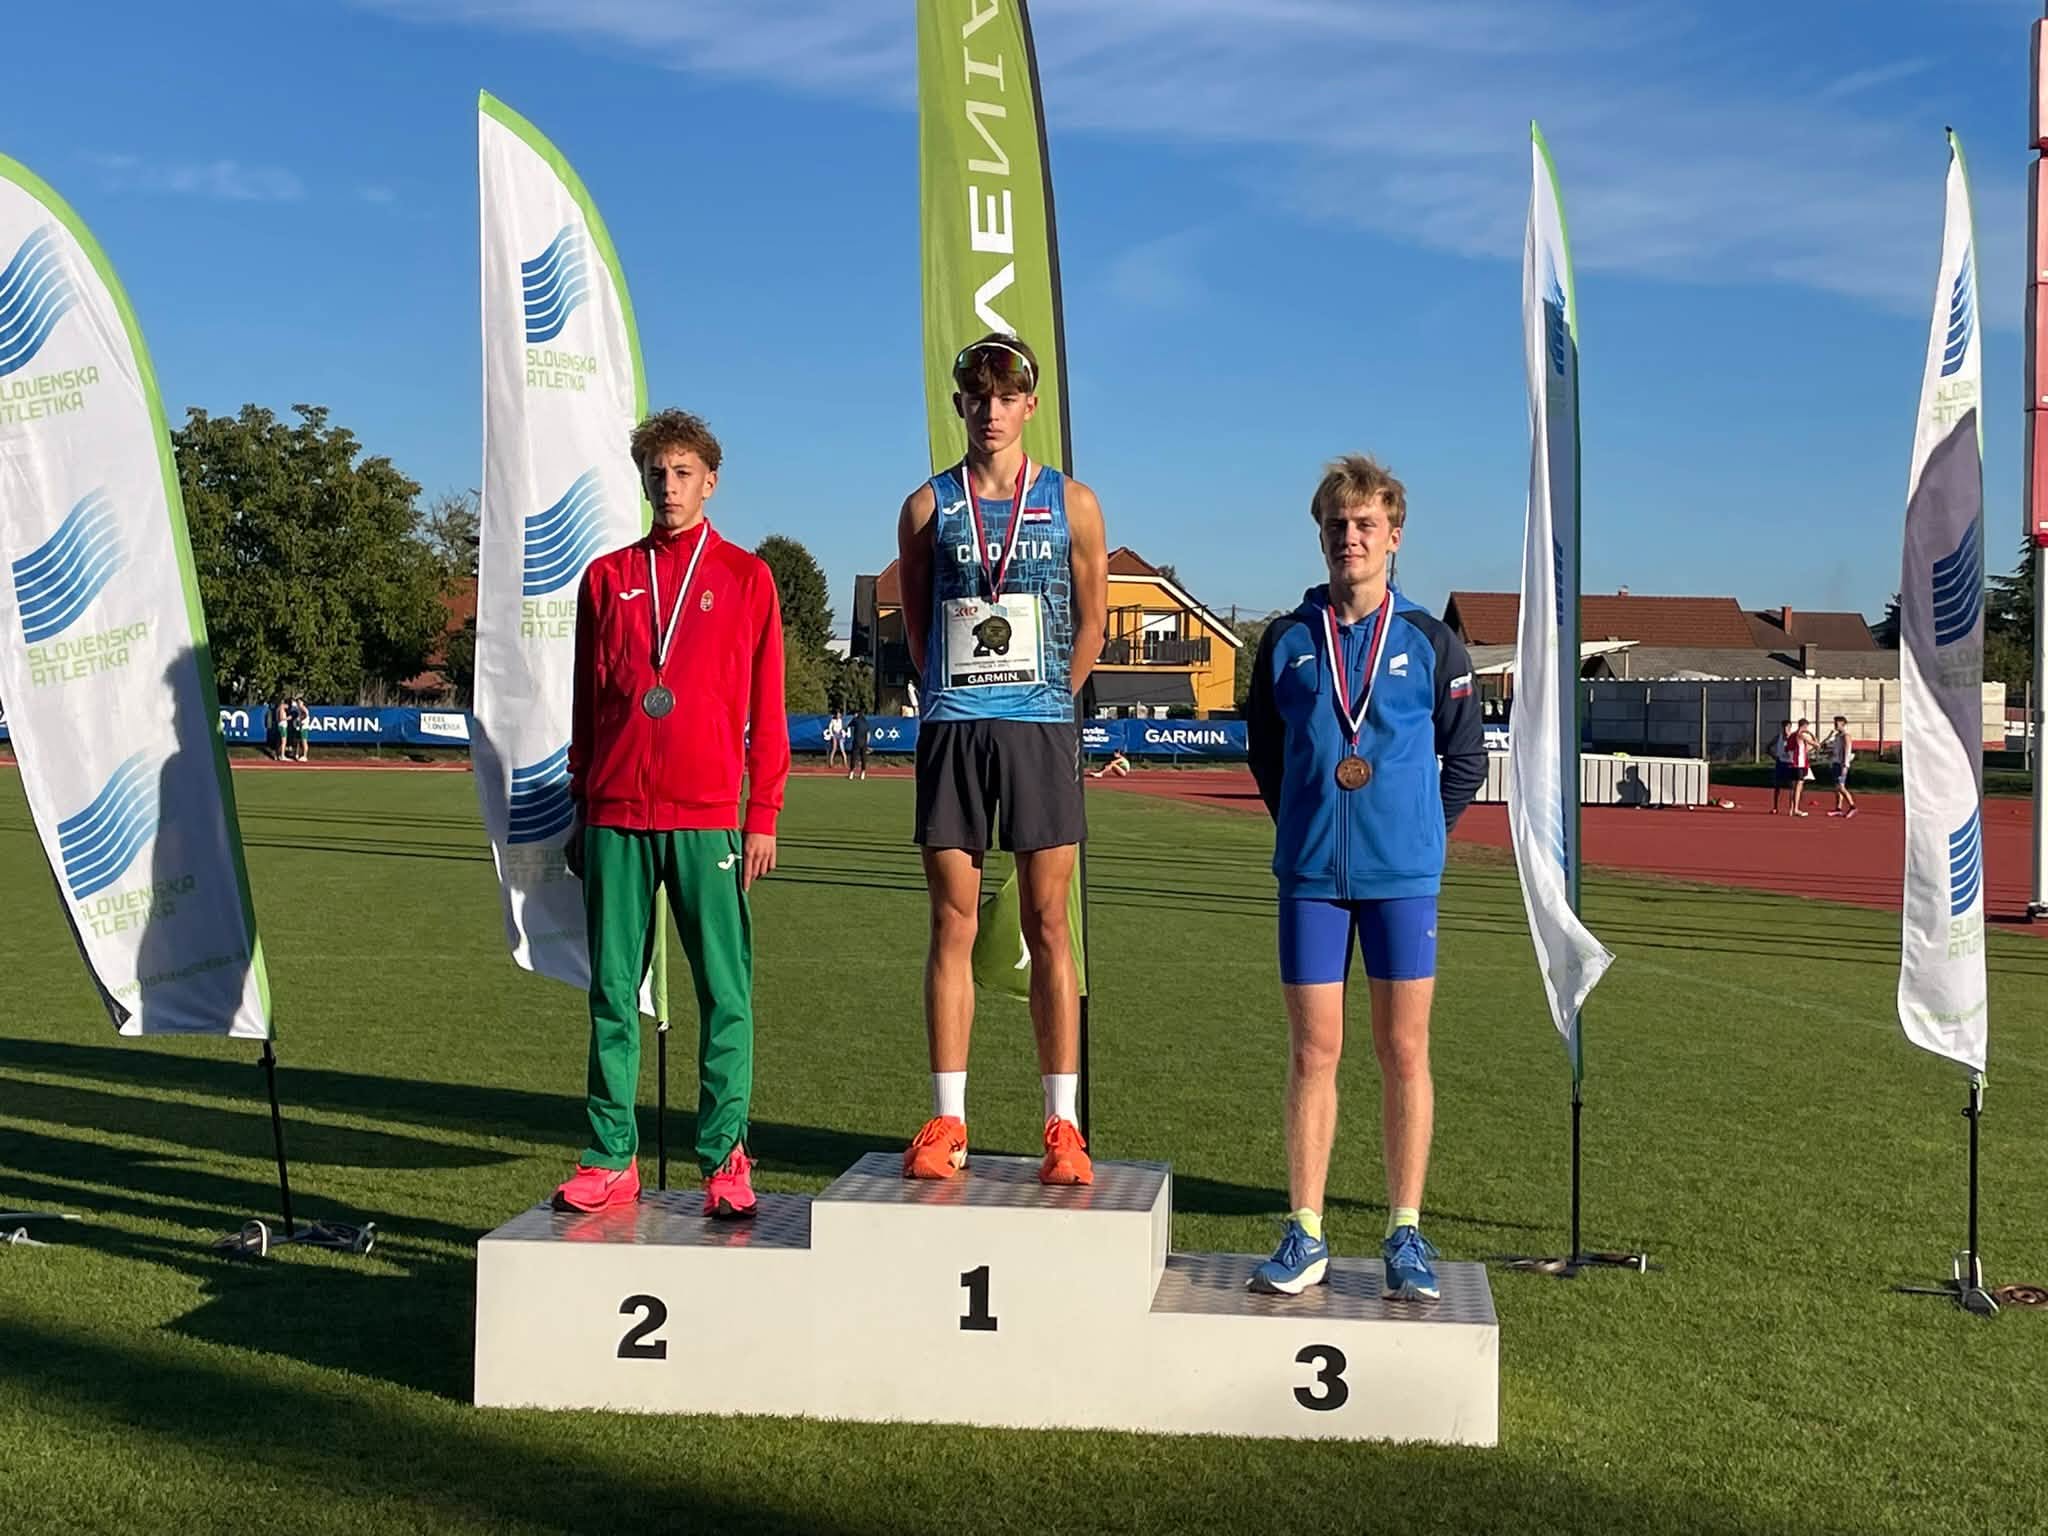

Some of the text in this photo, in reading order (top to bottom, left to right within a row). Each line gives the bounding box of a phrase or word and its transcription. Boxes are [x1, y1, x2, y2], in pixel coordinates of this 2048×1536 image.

[526, 348, 597, 374] SLOVENSKA
[526, 369, 585, 392] ATLETIKA
[27, 622, 149, 667] SLOVENSKA
[31, 648, 129, 688] ATLETIKA
[960, 1266, 998, 1332] 1
[617, 1294, 668, 1361] 2
[1293, 1344, 1349, 1411] 3
